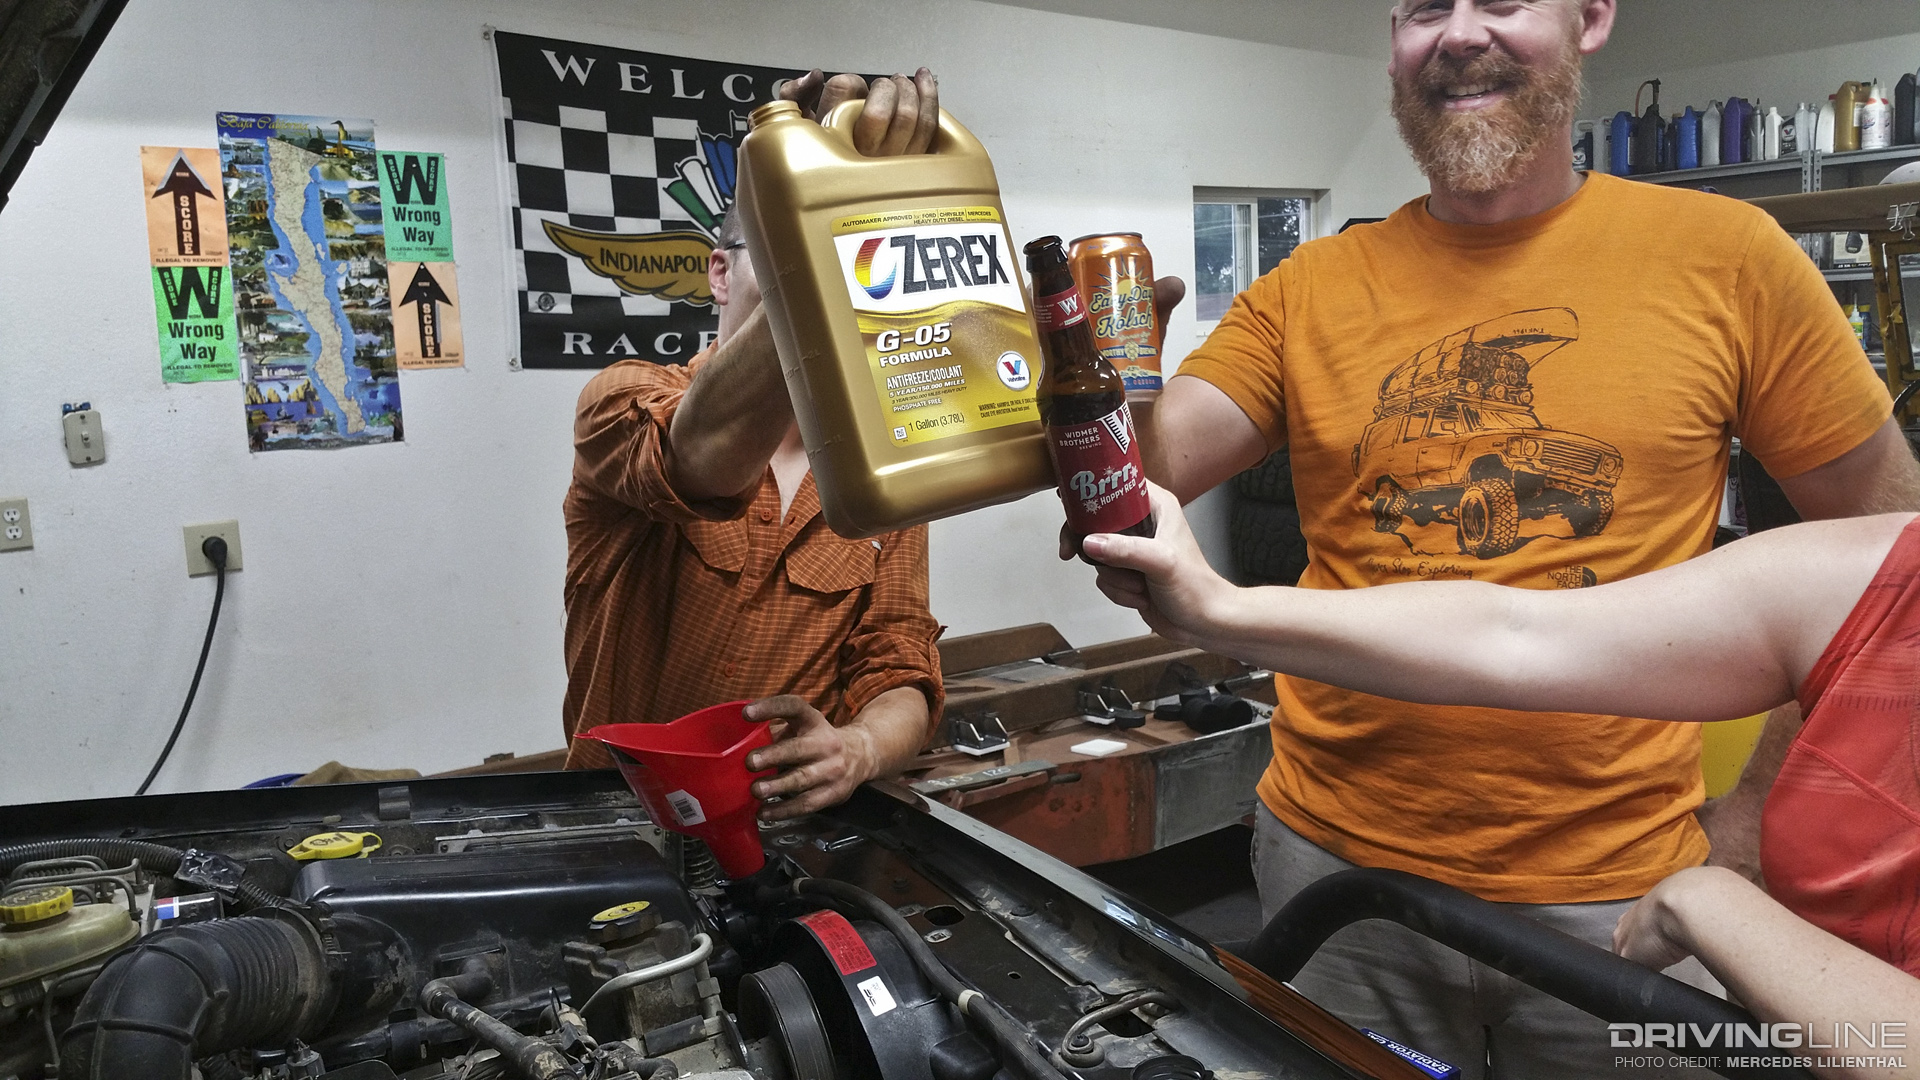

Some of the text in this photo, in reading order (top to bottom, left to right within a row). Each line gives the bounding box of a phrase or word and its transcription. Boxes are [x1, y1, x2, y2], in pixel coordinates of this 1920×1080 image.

[218, 114, 309, 132] Baja California
[180, 195, 193, 254] SCORE
[392, 206, 441, 226] Wrong
[842, 217, 881, 228] AUTOMAKER
[882, 214, 912, 223] APPROVED
[403, 227, 434, 246] Way
[600, 247, 709, 274] INDIANAPOLI
[890, 235, 1010, 294] ZEREX
[168, 322, 224, 341] Wrong
[422, 303, 435, 357] SCORE
[876, 322, 952, 352] G-05
[180, 342, 216, 362] Way
[879, 346, 952, 368] FORMULA
[886, 365, 963, 389] ANTIFREEZE/COOLANT
[944, 379, 965, 387] MILES
[893, 398, 942, 412] PHOSPHATE FREE
[908, 412, 964, 431] 1 Gallon (3.78L)
[1060, 434, 1100, 447] BROTHERS
[1065, 426, 1098, 439] WIDMER
[1079, 442, 1102, 450] BREWING
[1070, 462, 1131, 500] Brrr
[1100, 487, 1123, 506] HOPPY
[1124, 478, 1136, 493] RED
[1417, 561, 1473, 580] Exploring
[1547, 572, 1582, 581] NORTH
[1564, 565, 1581, 573] THE
[1557, 580, 1580, 589] FACE
[1387, 1044, 1450, 1073] RADIATOR
